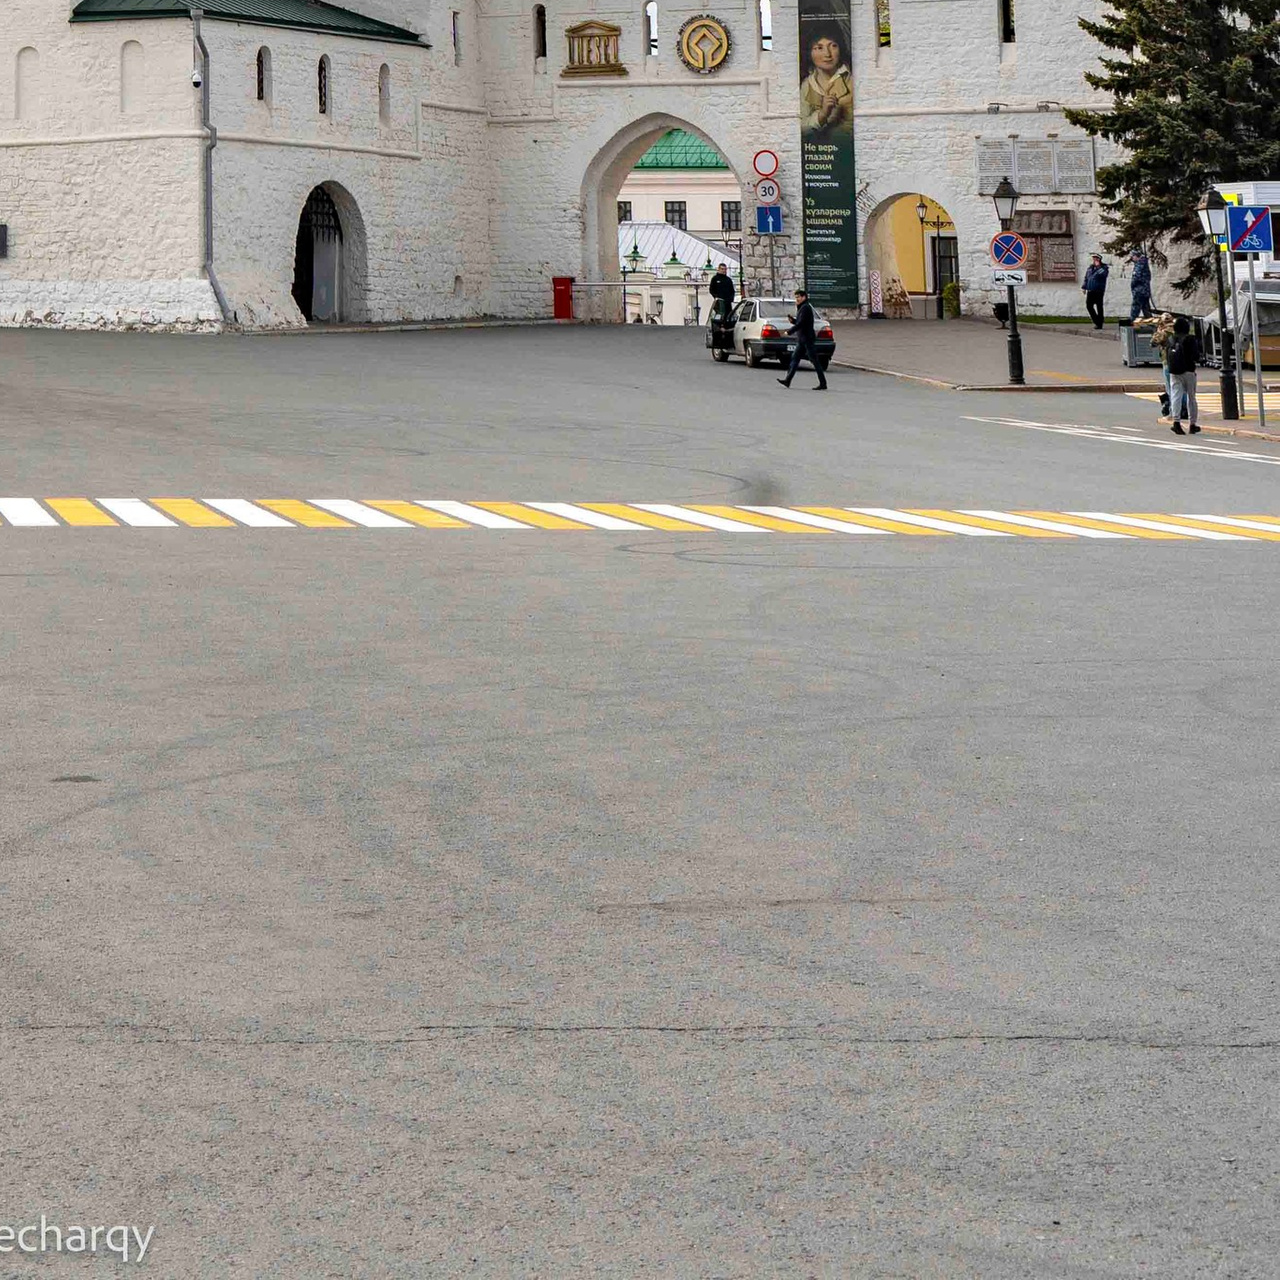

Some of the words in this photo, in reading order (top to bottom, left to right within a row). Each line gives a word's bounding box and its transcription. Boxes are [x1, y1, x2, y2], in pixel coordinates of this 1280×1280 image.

[805, 143, 816, 151] Не
[818, 144, 838, 153] верь
[761, 185, 775, 197] 30
